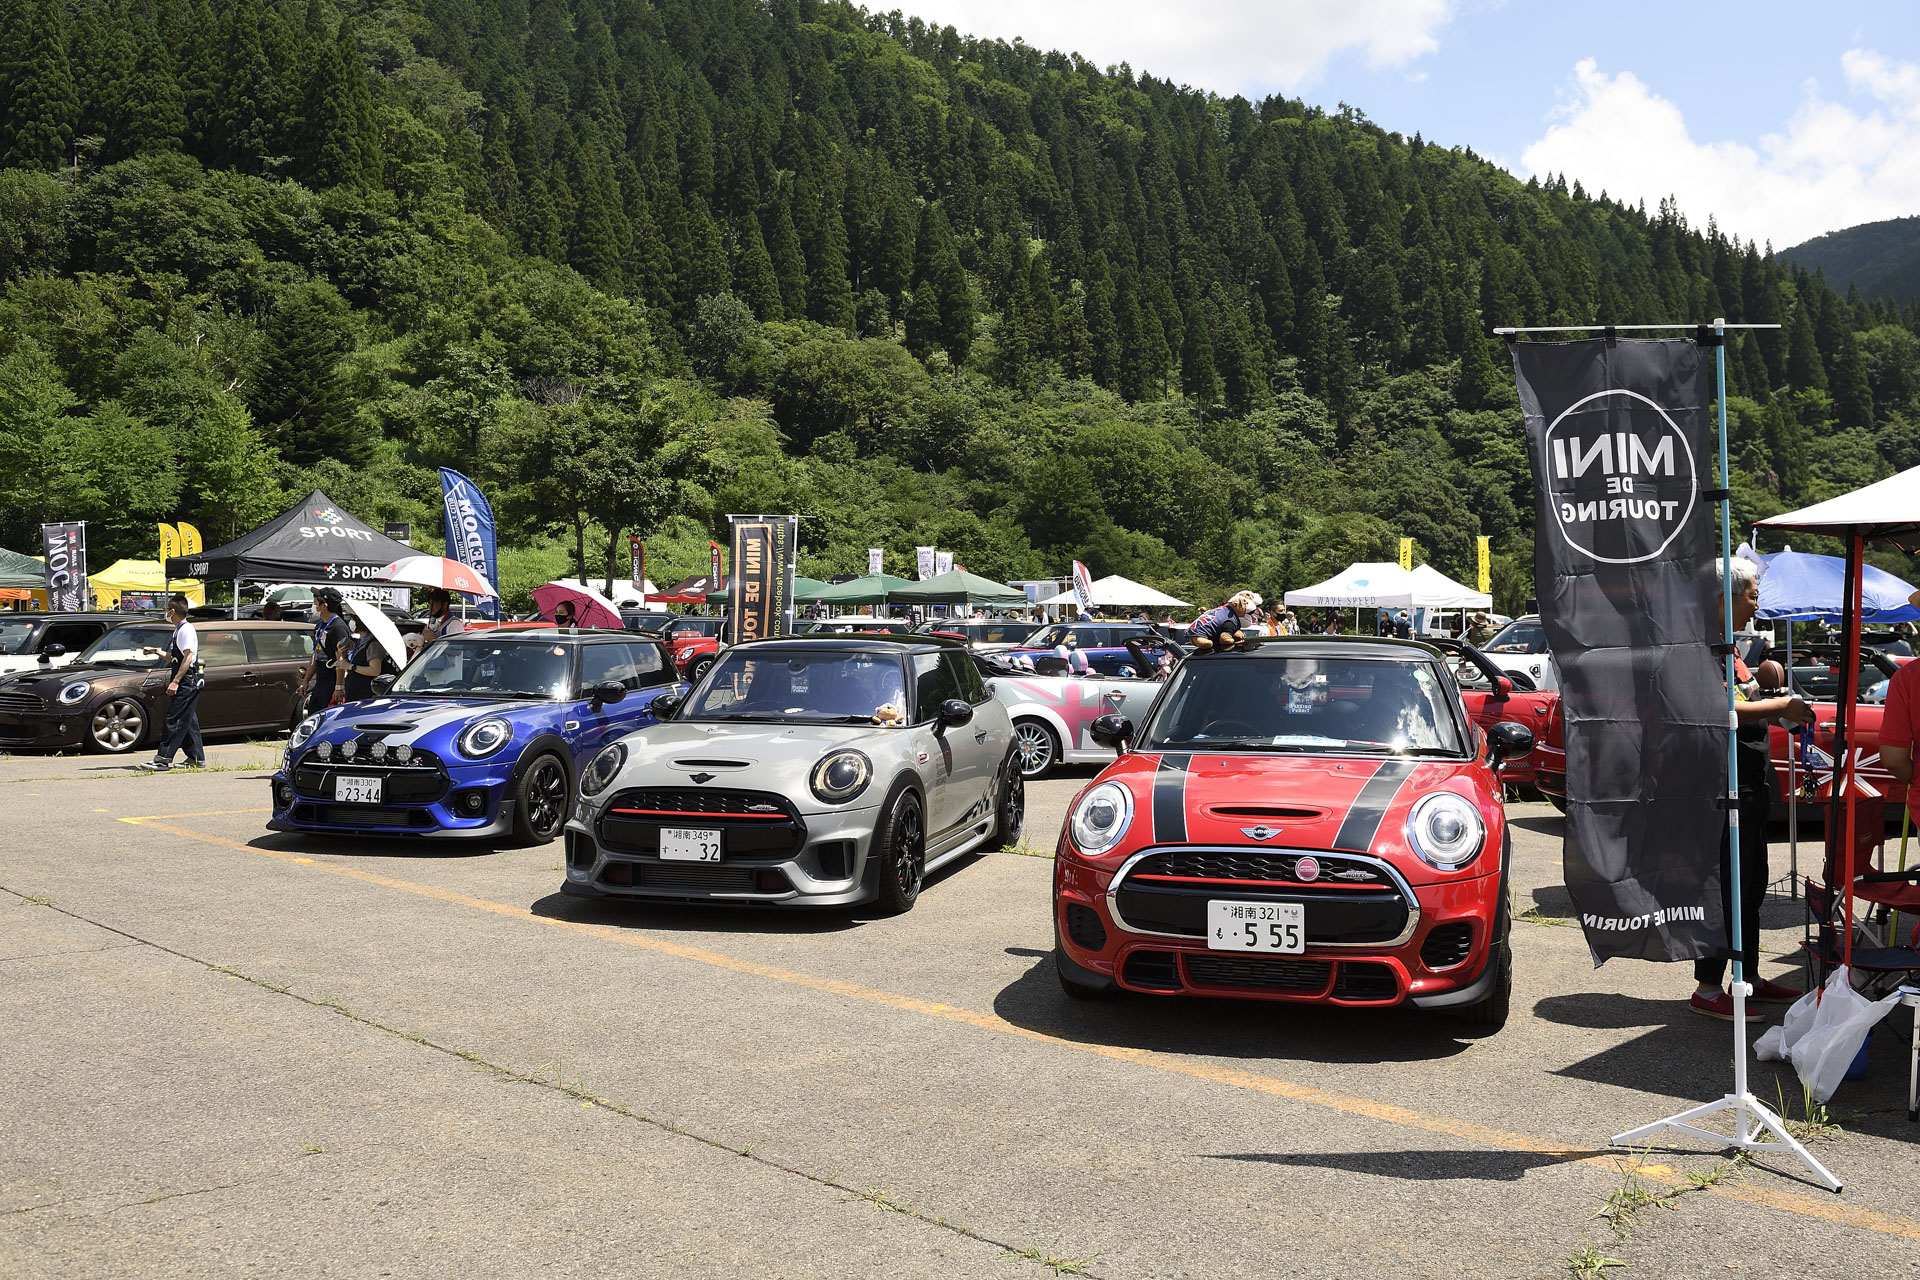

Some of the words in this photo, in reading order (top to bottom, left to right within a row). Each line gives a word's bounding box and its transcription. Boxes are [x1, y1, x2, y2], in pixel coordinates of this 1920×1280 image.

[300, 526, 373, 541] SPORT
[193, 562, 209, 576] SPORT
[342, 565, 385, 579] SPOR
[1316, 596, 1342, 605] WAVE
[1346, 596, 1377, 605] SPEED
[360, 778, 373, 787] 330
[345, 787, 380, 802] 23-44
[673, 829, 691, 840] 湘南
[692, 830, 708, 841] 349
[1230, 905, 1257, 920] 湘南
[1259, 906, 1281, 921] 321
